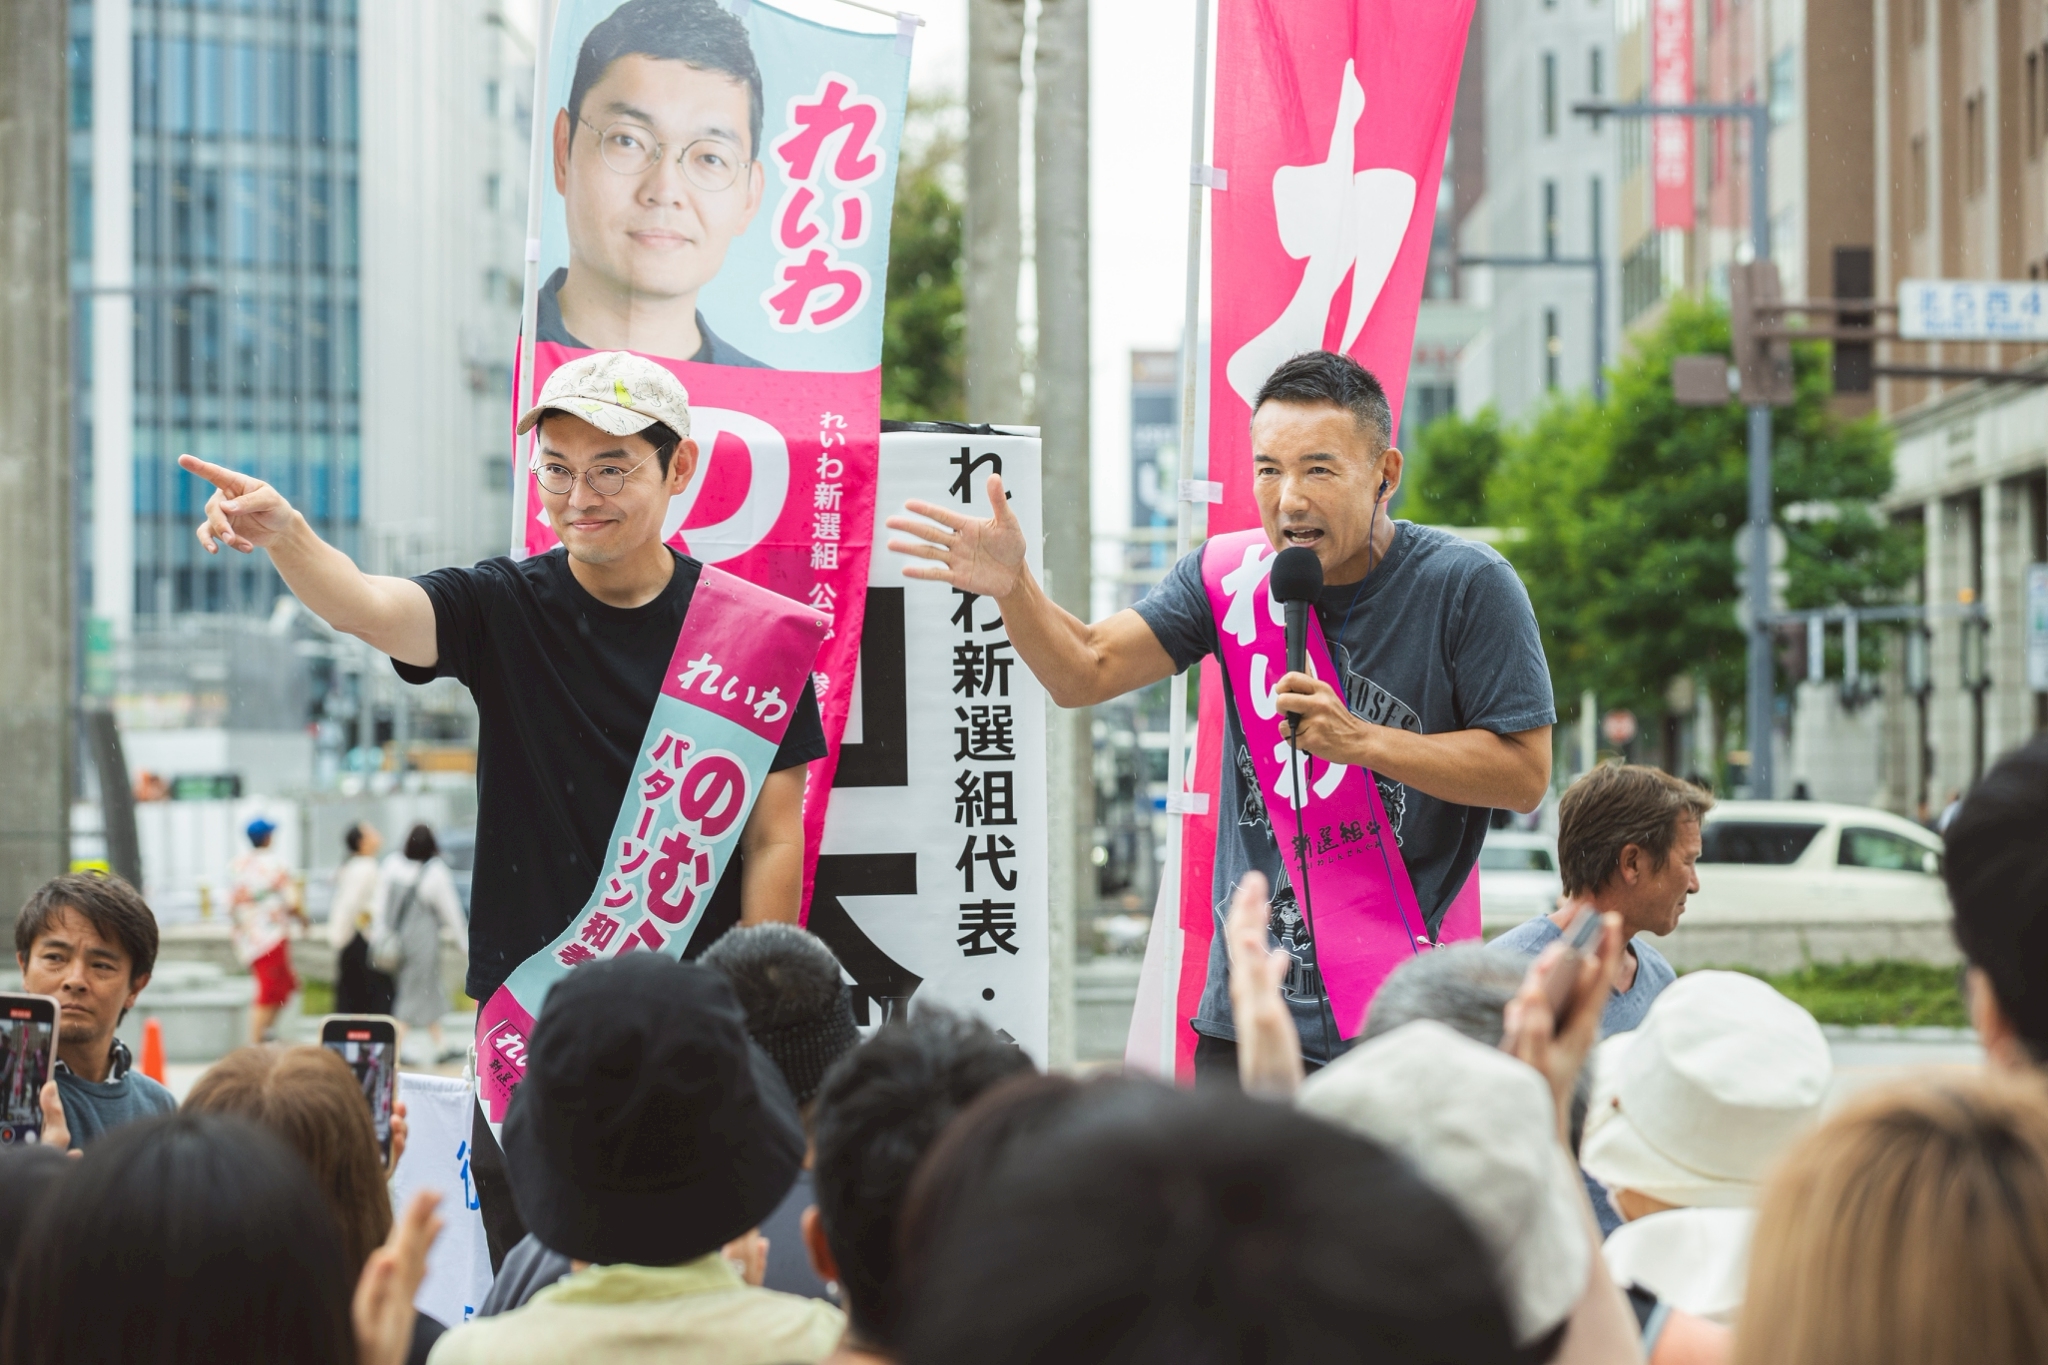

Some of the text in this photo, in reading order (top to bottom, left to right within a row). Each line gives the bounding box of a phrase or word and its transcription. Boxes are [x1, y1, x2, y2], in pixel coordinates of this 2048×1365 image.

[768, 80, 877, 326] れいわ
[810, 411, 848, 571] れいわ新選組
[677, 652, 788, 723] れいわ
